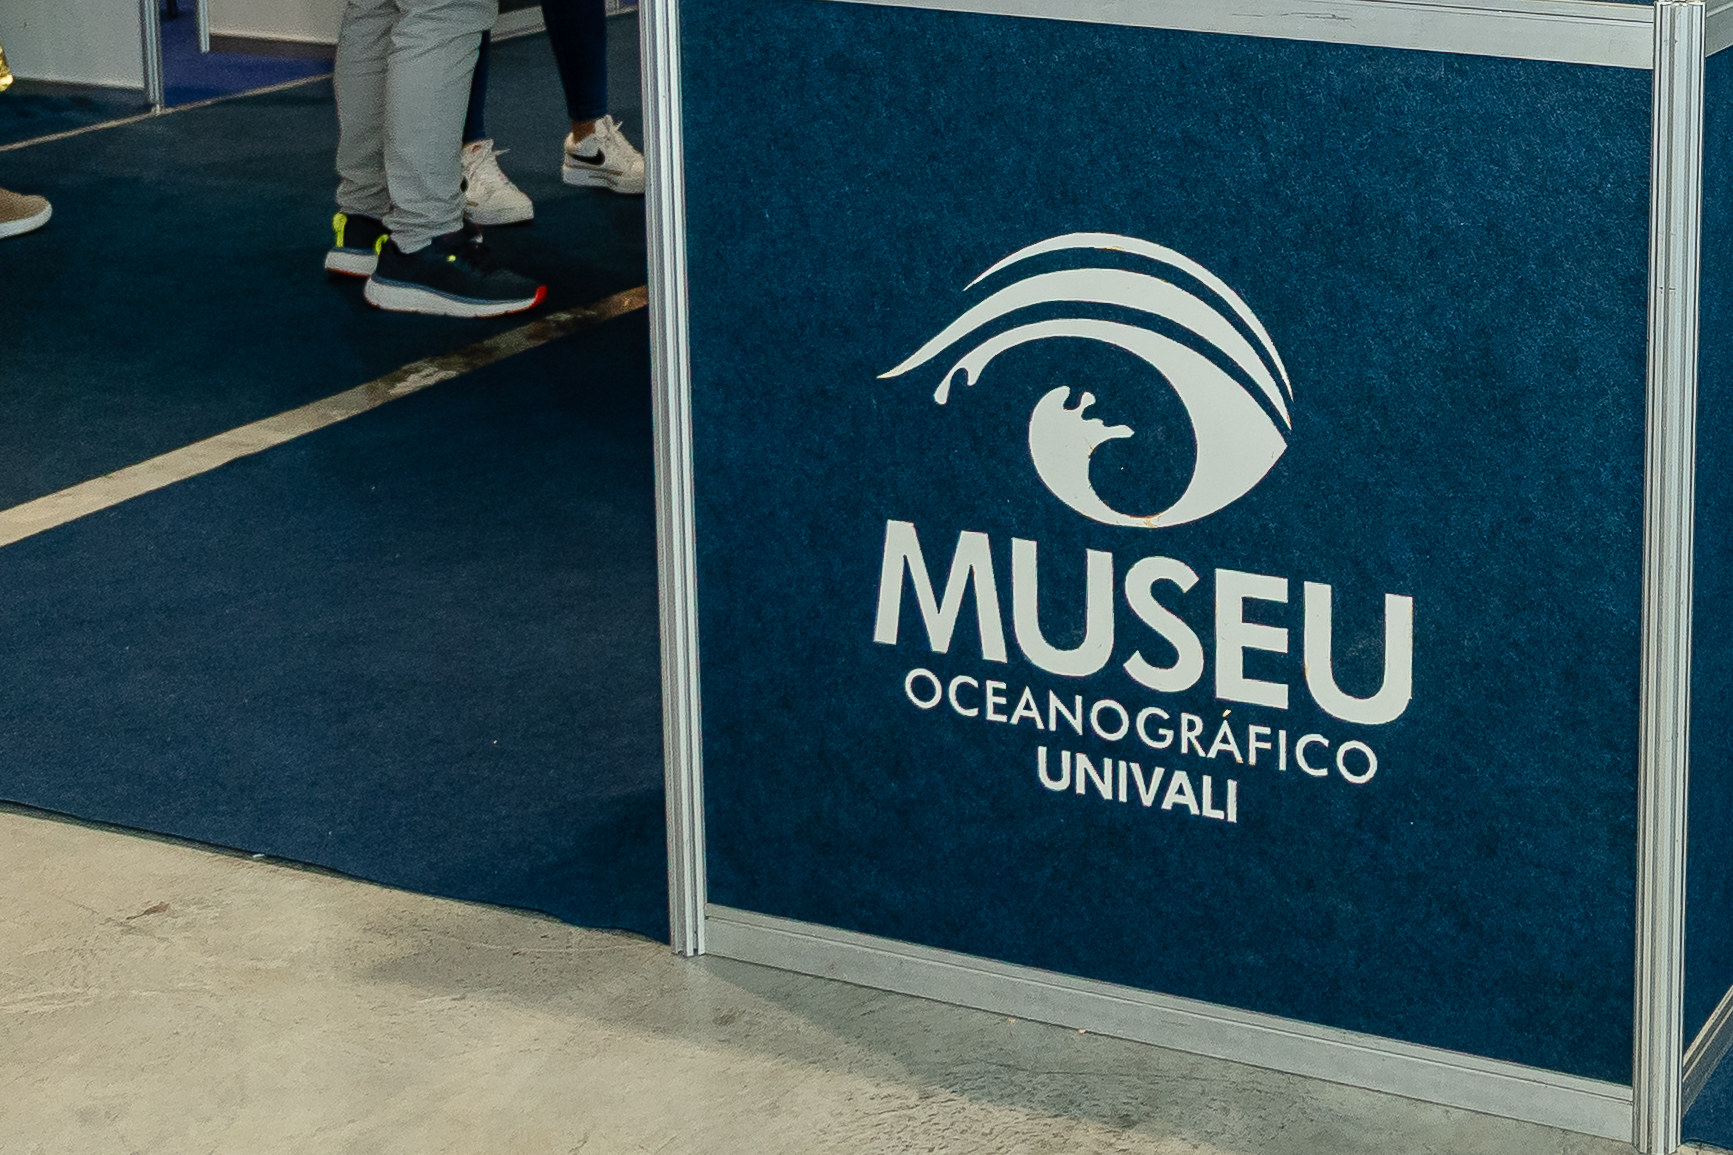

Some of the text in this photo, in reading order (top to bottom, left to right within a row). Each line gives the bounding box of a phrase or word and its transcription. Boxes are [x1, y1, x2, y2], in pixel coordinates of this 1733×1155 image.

[873, 518, 1414, 726] MUSEU
[905, 668, 1378, 784] OCEANOGRÁFICO
[1037, 746, 1238, 823] UNIVALI
